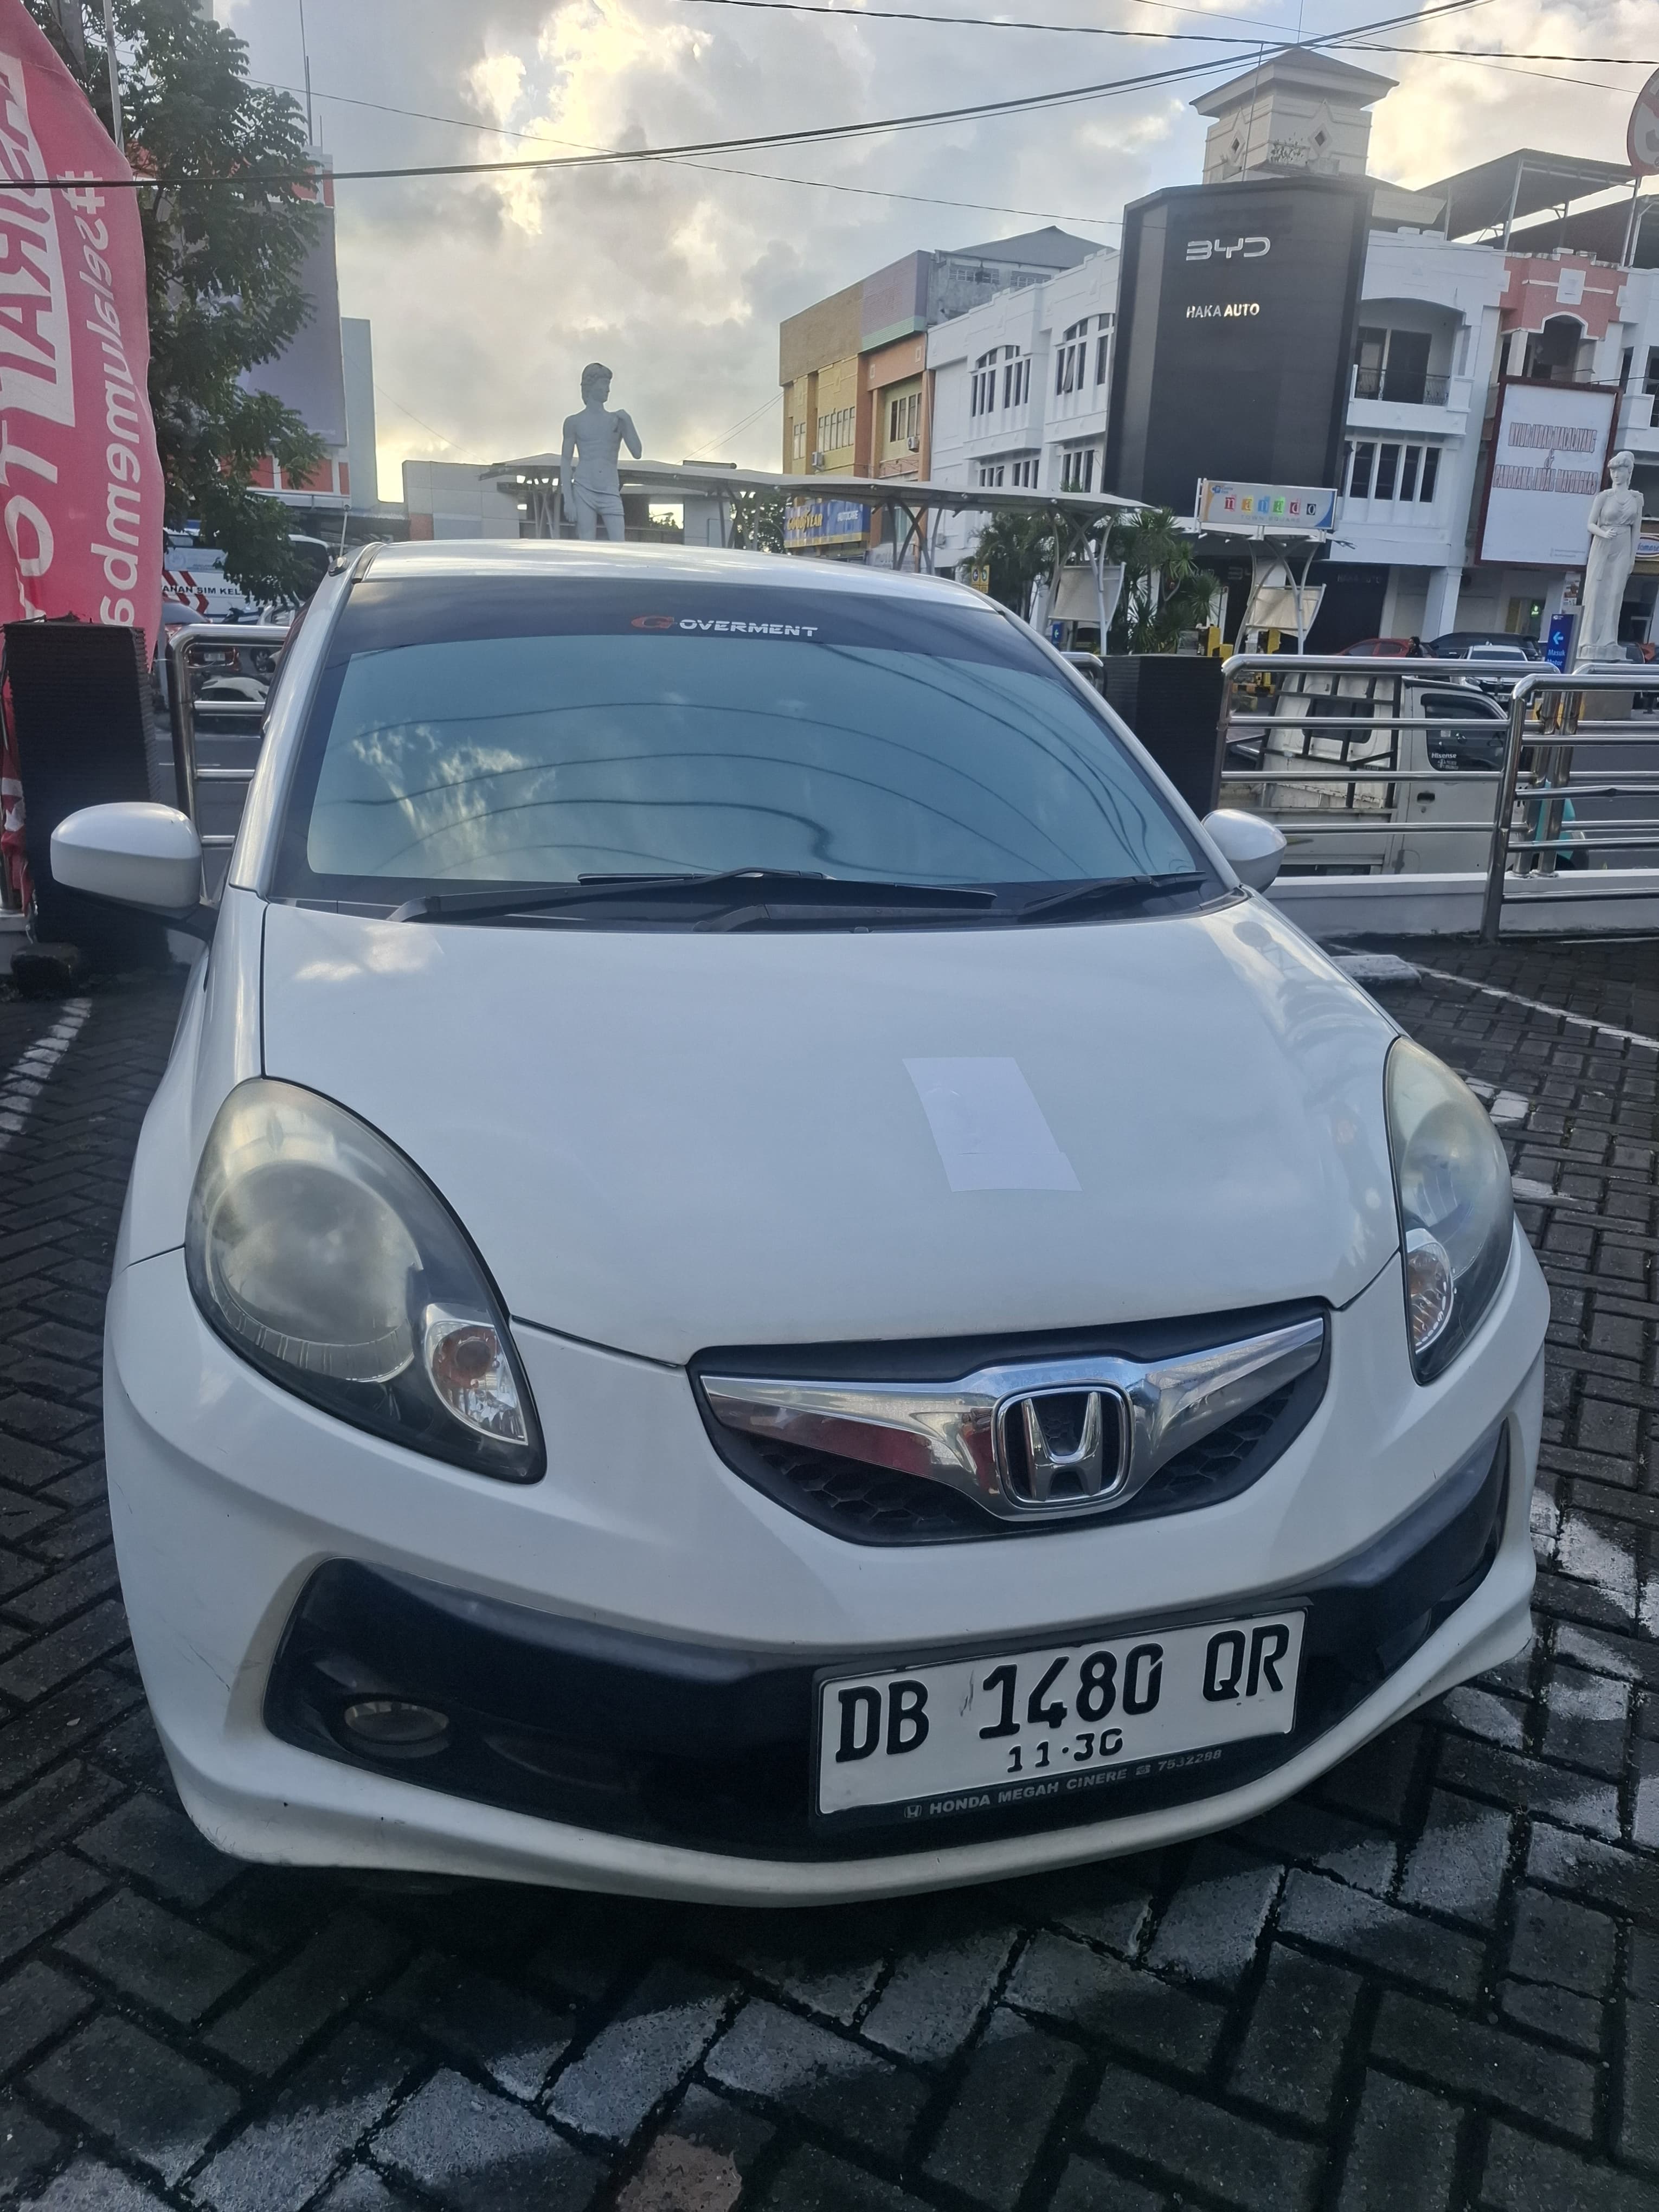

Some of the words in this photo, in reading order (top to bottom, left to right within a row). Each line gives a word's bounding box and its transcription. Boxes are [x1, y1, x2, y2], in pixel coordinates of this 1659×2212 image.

[1186, 237, 1271, 261] BYD
[1186, 305, 1221, 318] HAKA
[1224, 303, 1260, 317] AUTO
[787, 513, 823, 531] GOODYEAR
[835, 1680, 929, 1762] DB
[979, 1643, 1164, 1739] 1480
[1203, 1624, 1290, 1702] QR
[929, 1795, 991, 1815] HONDA
[998, 1782, 1059, 1803] MEGAH
[1066, 1769, 1128, 1790] CINERE
